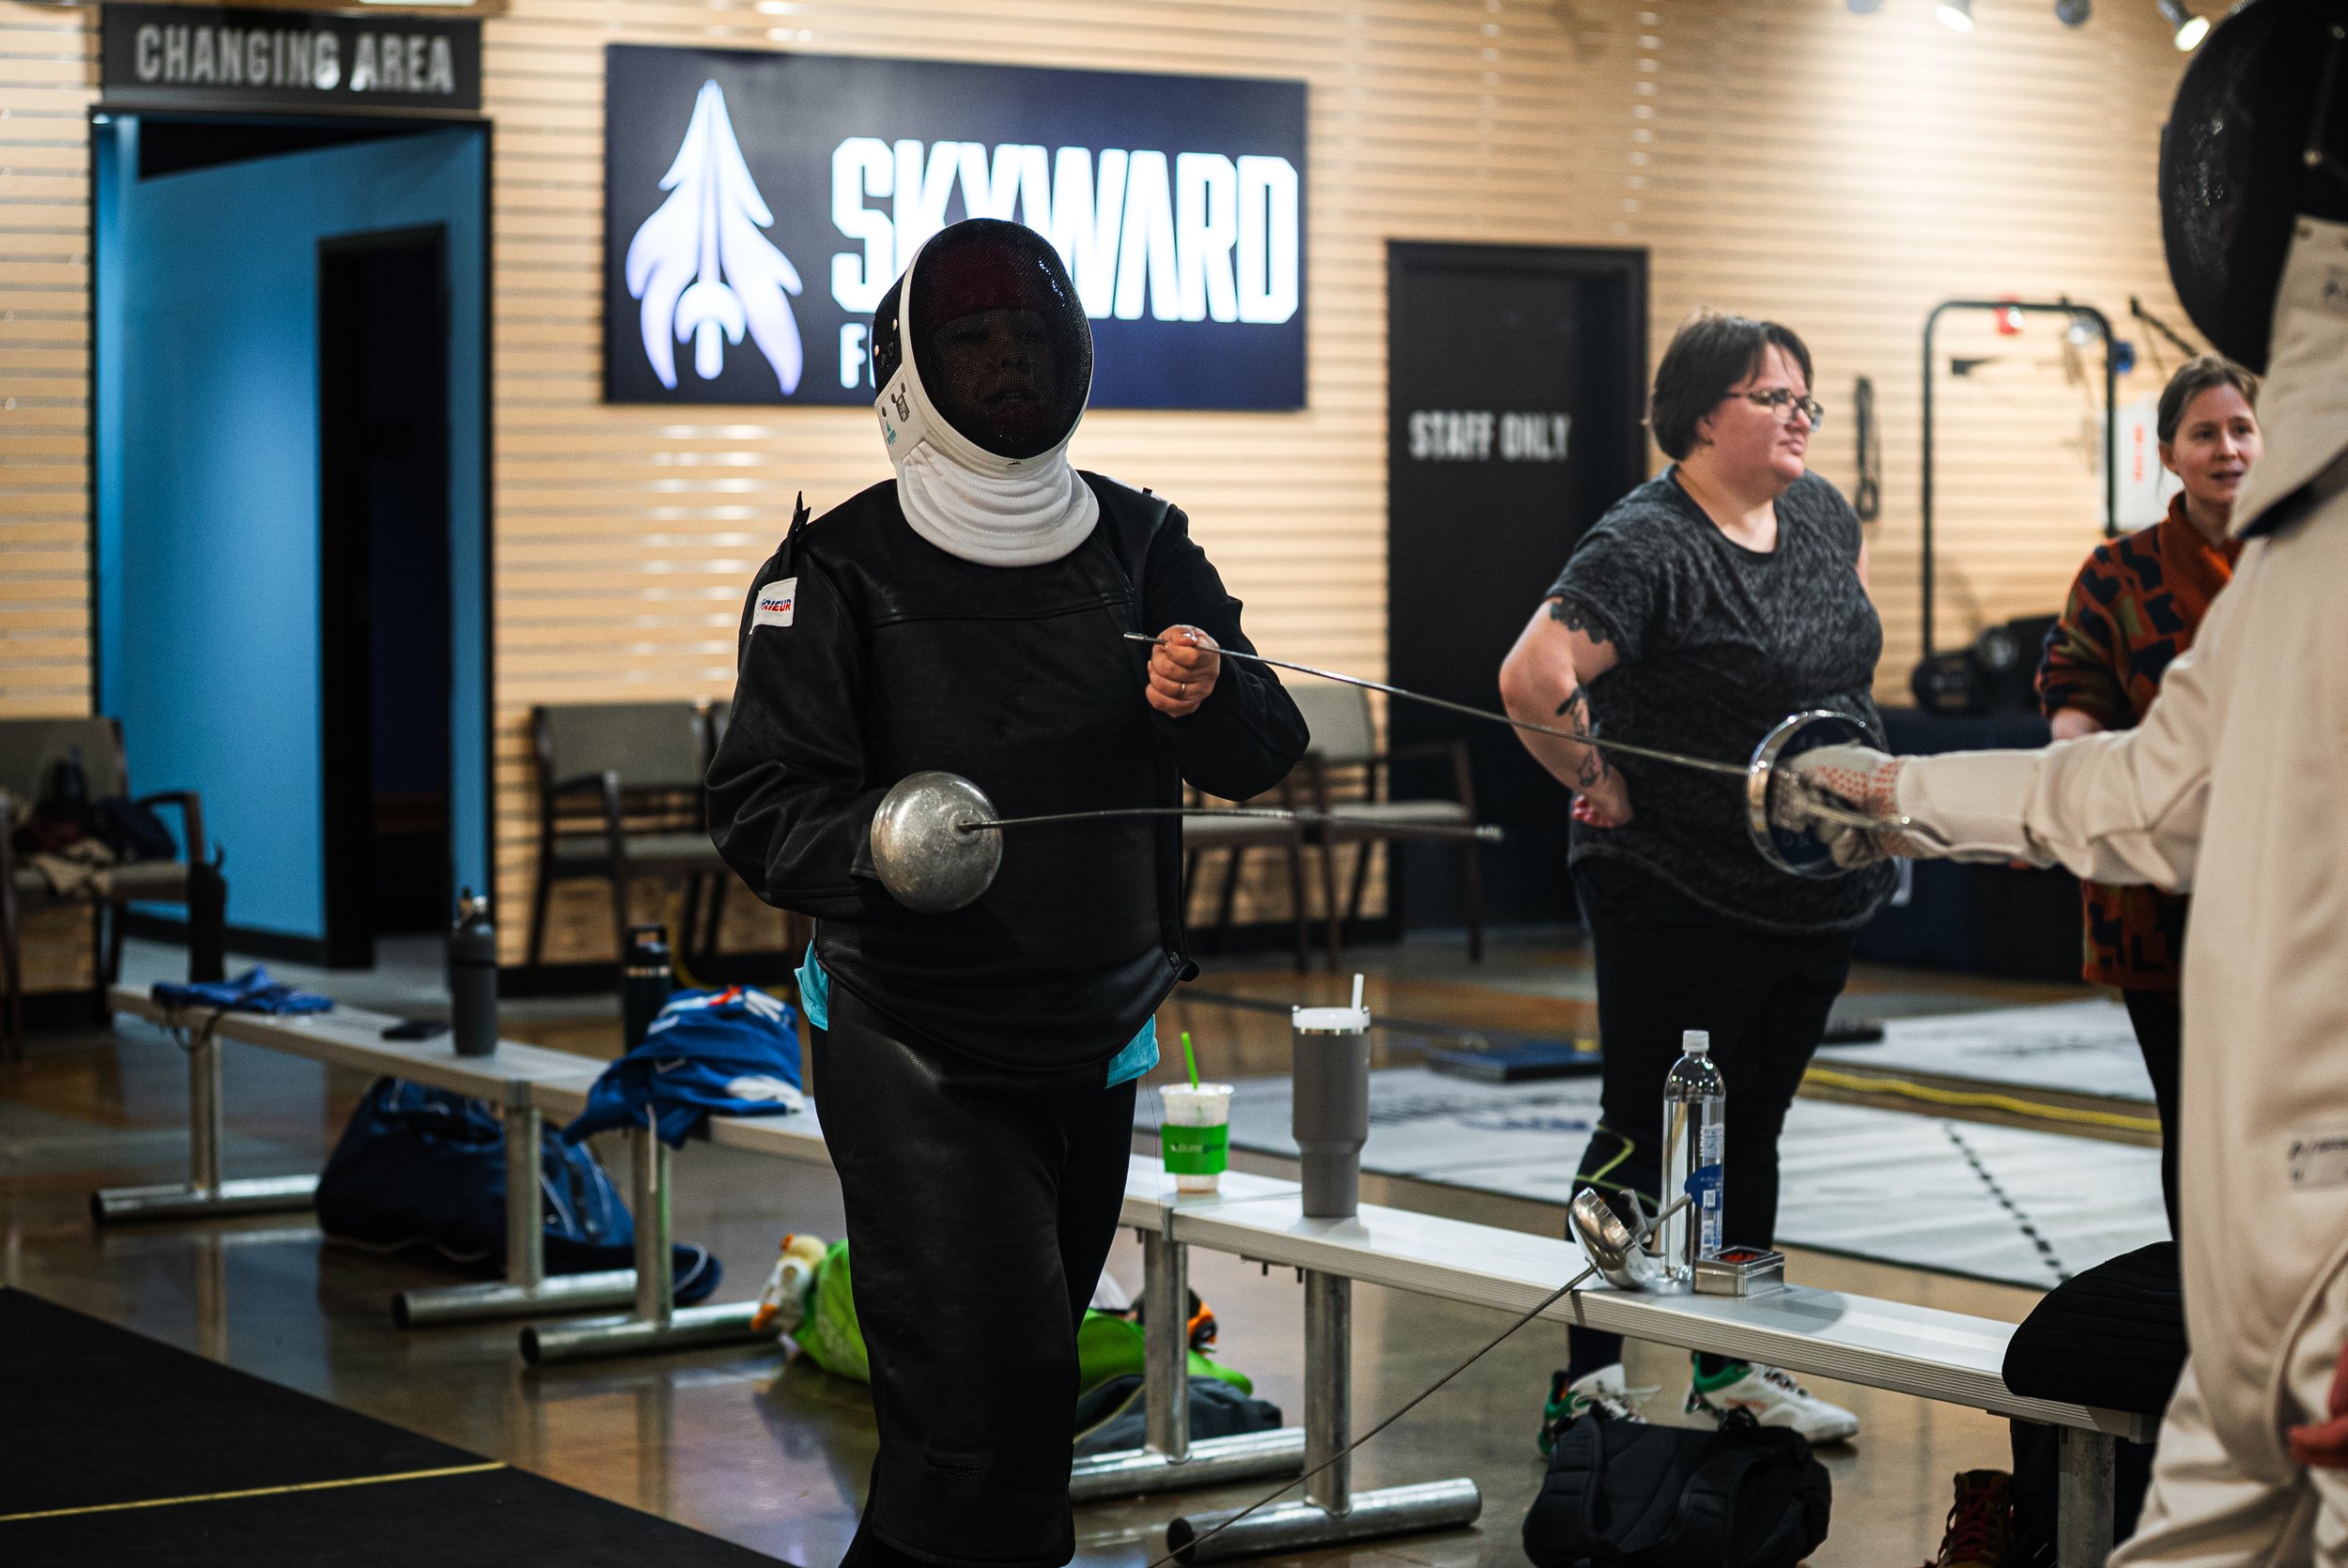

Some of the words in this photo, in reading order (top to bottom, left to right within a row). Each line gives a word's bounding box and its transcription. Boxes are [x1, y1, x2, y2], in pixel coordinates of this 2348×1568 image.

[135, 24, 340, 90] CHANGING
[349, 32, 455, 94] AREA
[1409, 409, 1493, 461] STAFF
[1499, 411, 1571, 462] ONLY
